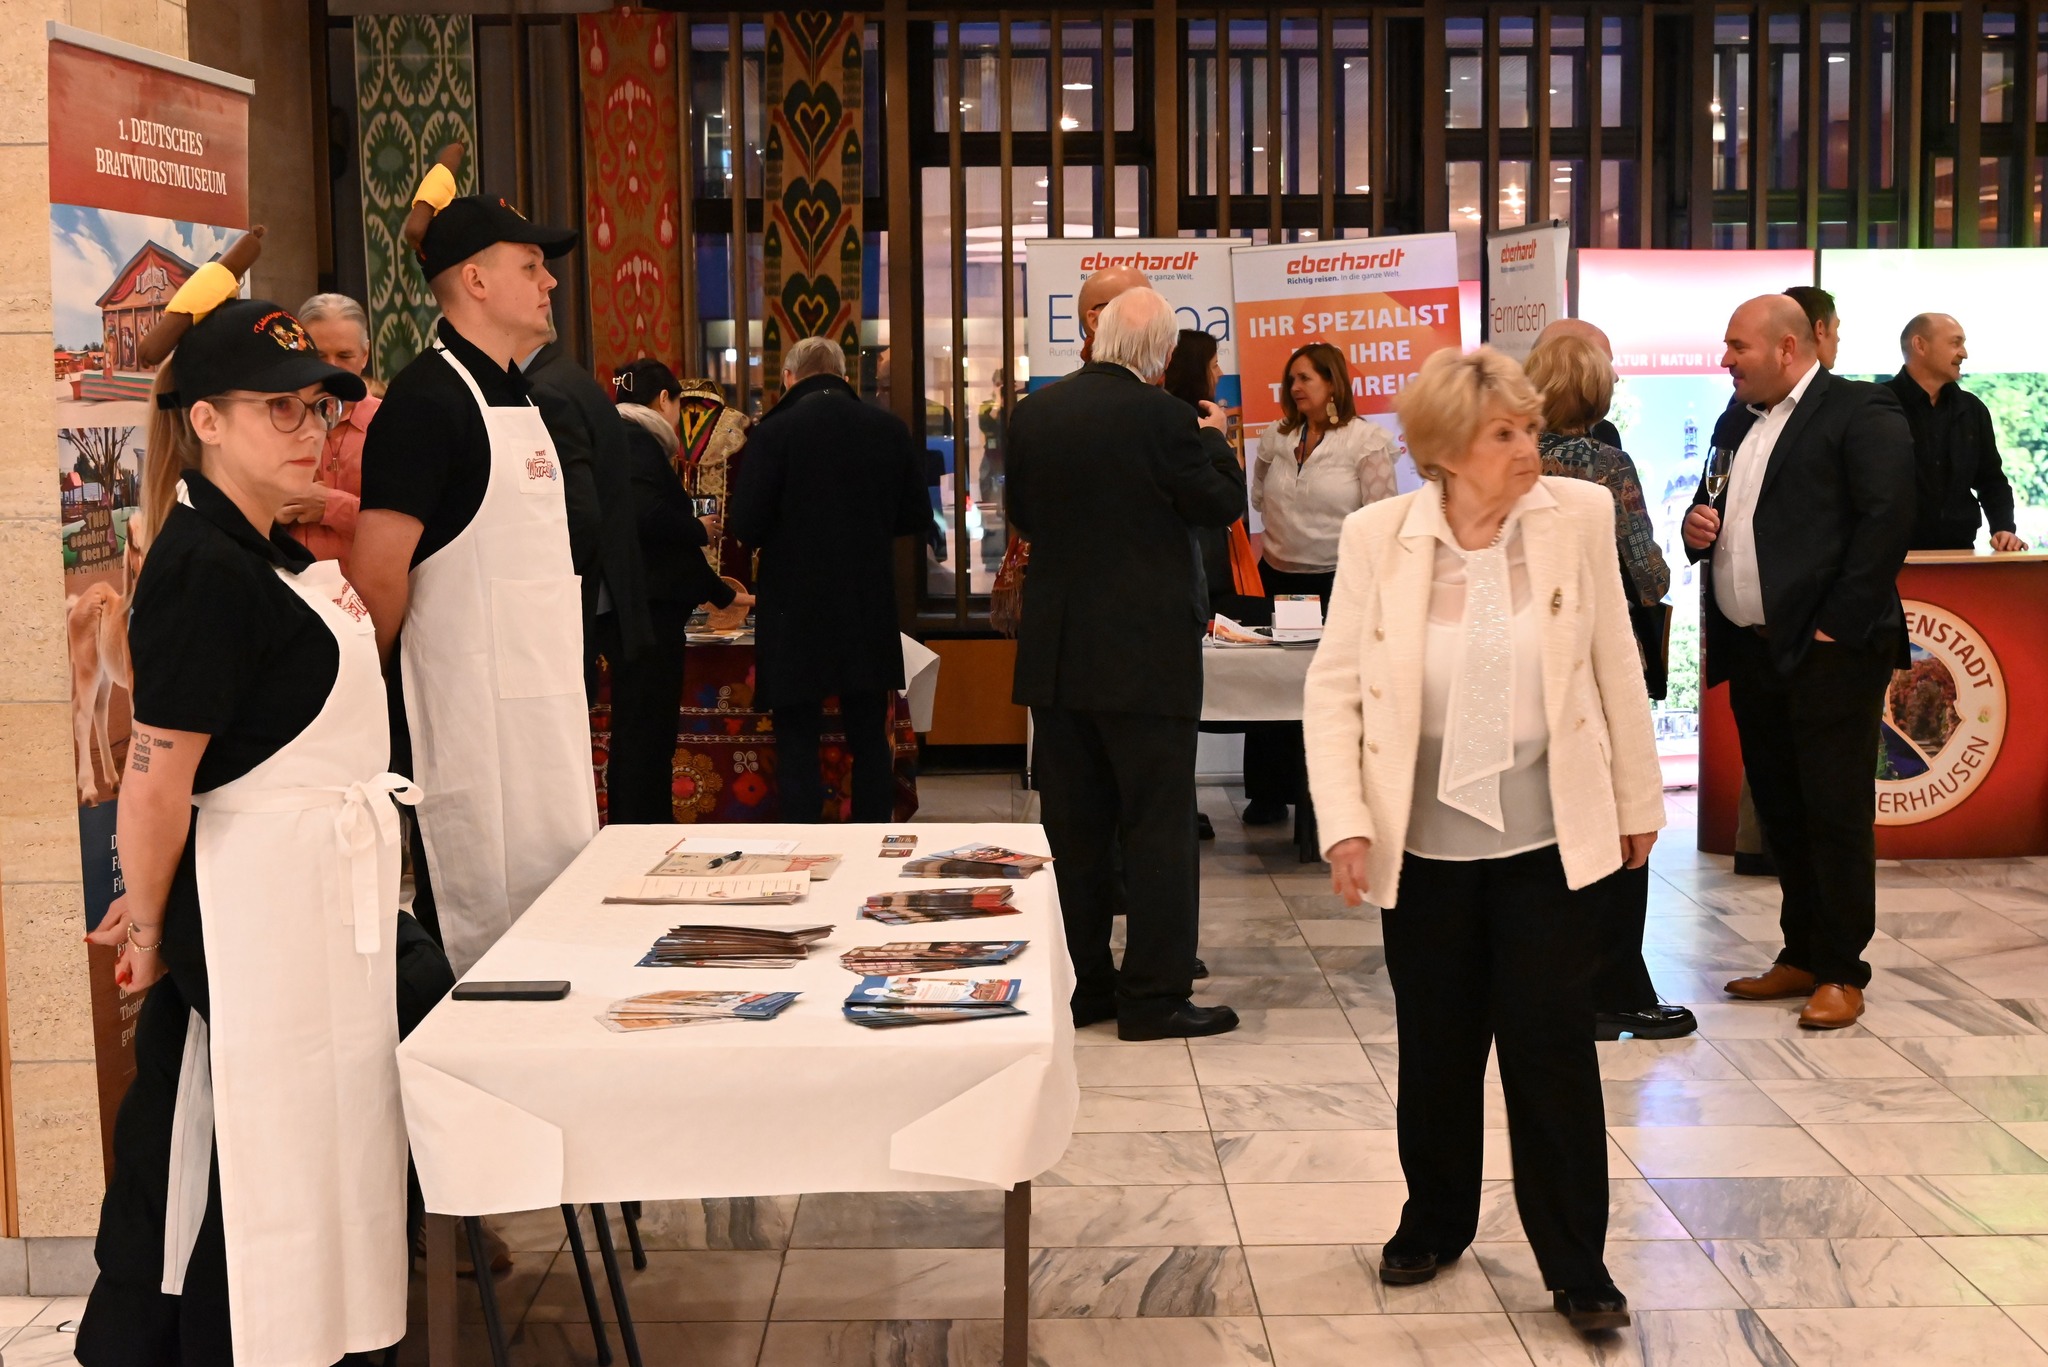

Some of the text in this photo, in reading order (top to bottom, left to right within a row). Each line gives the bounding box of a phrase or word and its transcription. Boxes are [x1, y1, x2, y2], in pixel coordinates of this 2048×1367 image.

[118, 117, 204, 156] 1. DEUTSCHES
[95, 147, 227, 195] BRATWURSTMUSEUM
[1080, 251, 1199, 271] eberhardt
[1286, 248, 1405, 275] eberhardt
[1501, 239, 1537, 263] eberhardt
[1154, 273, 1175, 282] ganze
[1287, 277, 1313, 285] Richtig
[1314, 275, 1339, 283] reisen.
[1362, 272, 1382, 281] ganze
[1249, 304, 1449, 338] IHR SPEZIALIST
[1490, 295, 1546, 333] Fernreisen
[1049, 347, 1081, 356] Rundre
[1350, 340, 1411, 364] IHRE
[1660, 353, 1703, 367] NATUR
[1904, 611, 1994, 689] ENSTADT
[1876, 735, 1989, 813] ERHAUSEN
